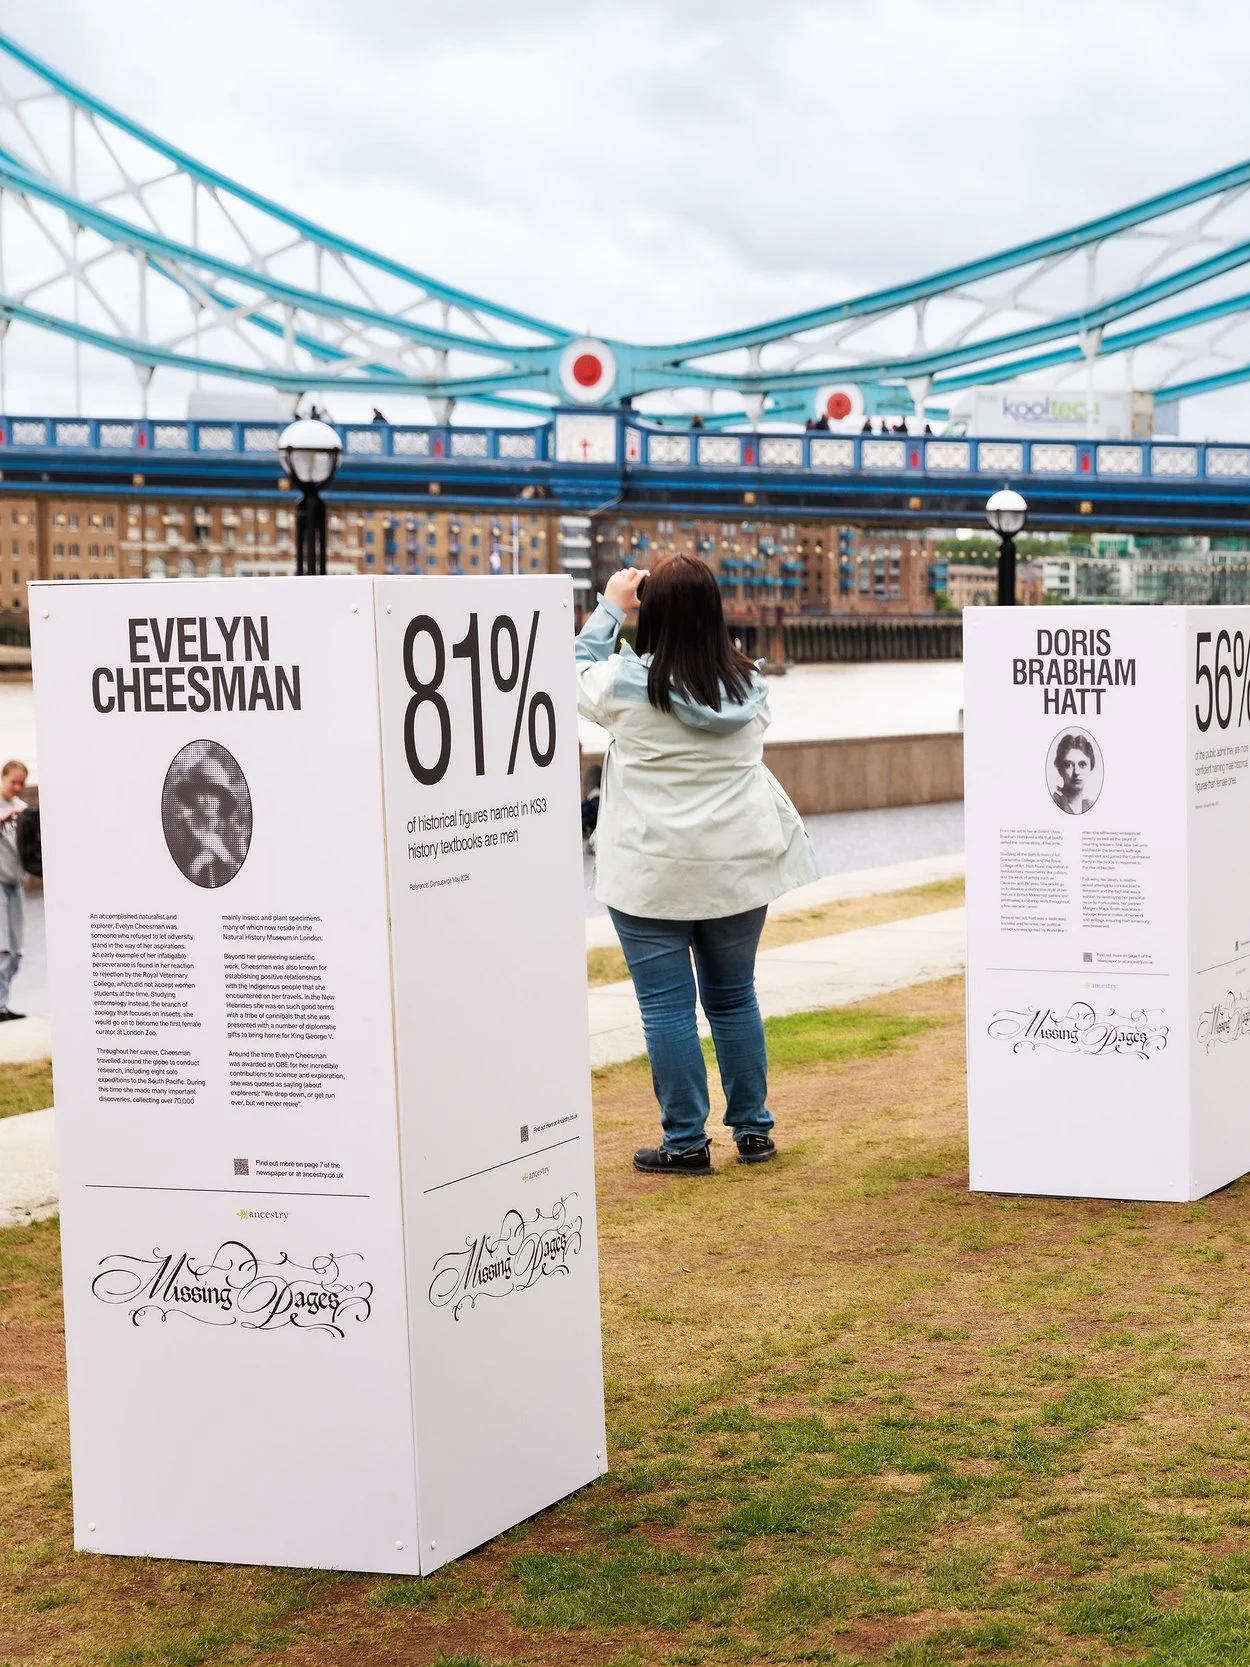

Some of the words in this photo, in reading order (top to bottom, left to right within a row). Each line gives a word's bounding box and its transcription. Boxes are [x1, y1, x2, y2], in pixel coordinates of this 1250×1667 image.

[128, 616, 269, 663] EVELYN
[1037, 628, 1111, 656] DORIS
[1013, 658, 1136, 686] BRABHAM
[92, 664, 301, 713] CHEESMAN
[402, 610, 556, 786] 81%
[1044, 688, 1106, 715] HATT
[407, 816, 416, 834] of
[418, 811, 457, 832] historical
[459, 810, 488, 828] figures
[490, 802, 519, 820] named
[521, 801, 528, 815] in
[530, 798, 547, 814] KS3
[408, 843, 438, 860] history
[440, 834, 482, 854] textbooks
[485, 834, 498, 847] are
[500, 830, 518, 844] men
[222, 914, 241, 922] mainly
[93, 980, 116, 988] College,
[159, 972, 188, 980] Veterinary
[94, 1000, 127, 1008] entomology
[151, 991, 176, 999] Studying
[529, 1165, 551, 1181] ancestry
[249, 1209, 289, 1222] ancestry
